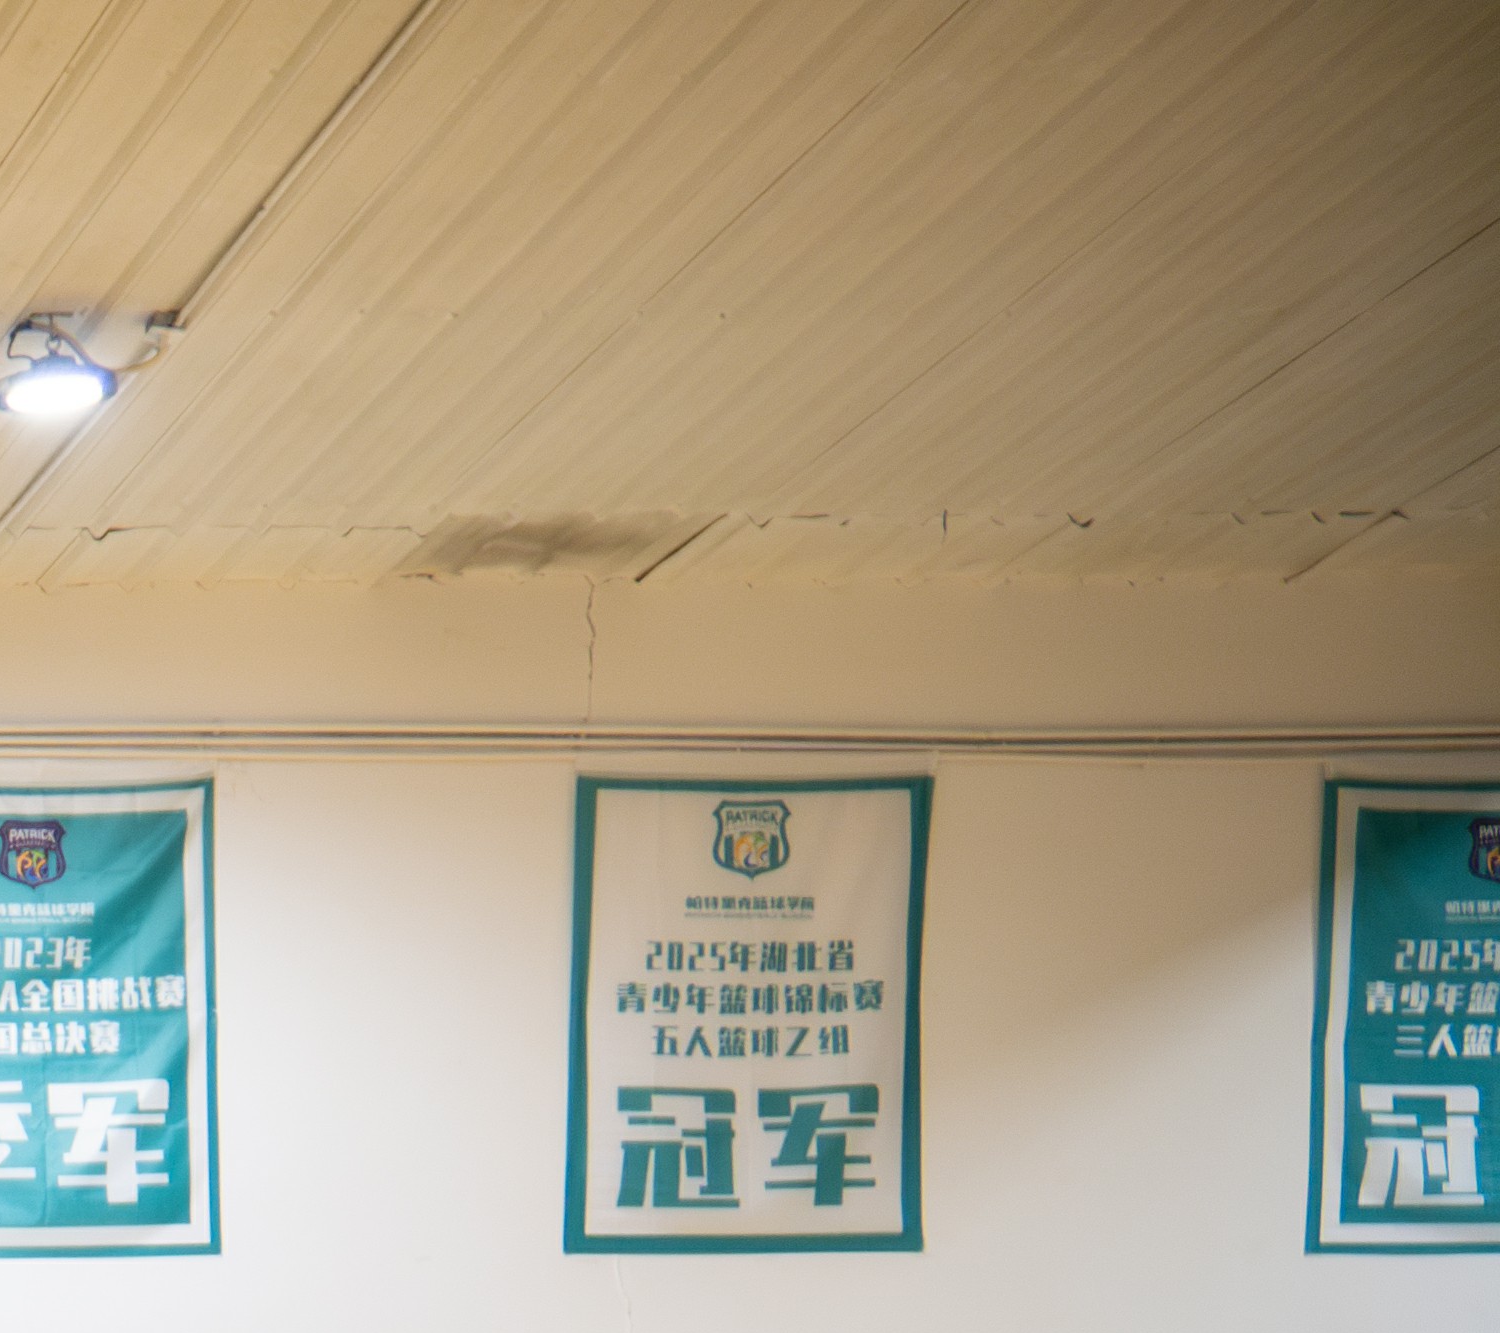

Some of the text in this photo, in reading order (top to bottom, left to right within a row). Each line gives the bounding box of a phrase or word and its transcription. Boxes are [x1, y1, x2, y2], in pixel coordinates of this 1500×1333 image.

[9, 828, 56, 843] PATRICK
[646, 940, 854, 972] 2025年湖北省
[617, 980, 884, 1015] 青少年篮球锦标赛
[651, 1025, 850, 1058] 五人篮球乙组
[617, 1084, 880, 1208] 冠军
[1358, 1084, 1485, 1208] 冠
